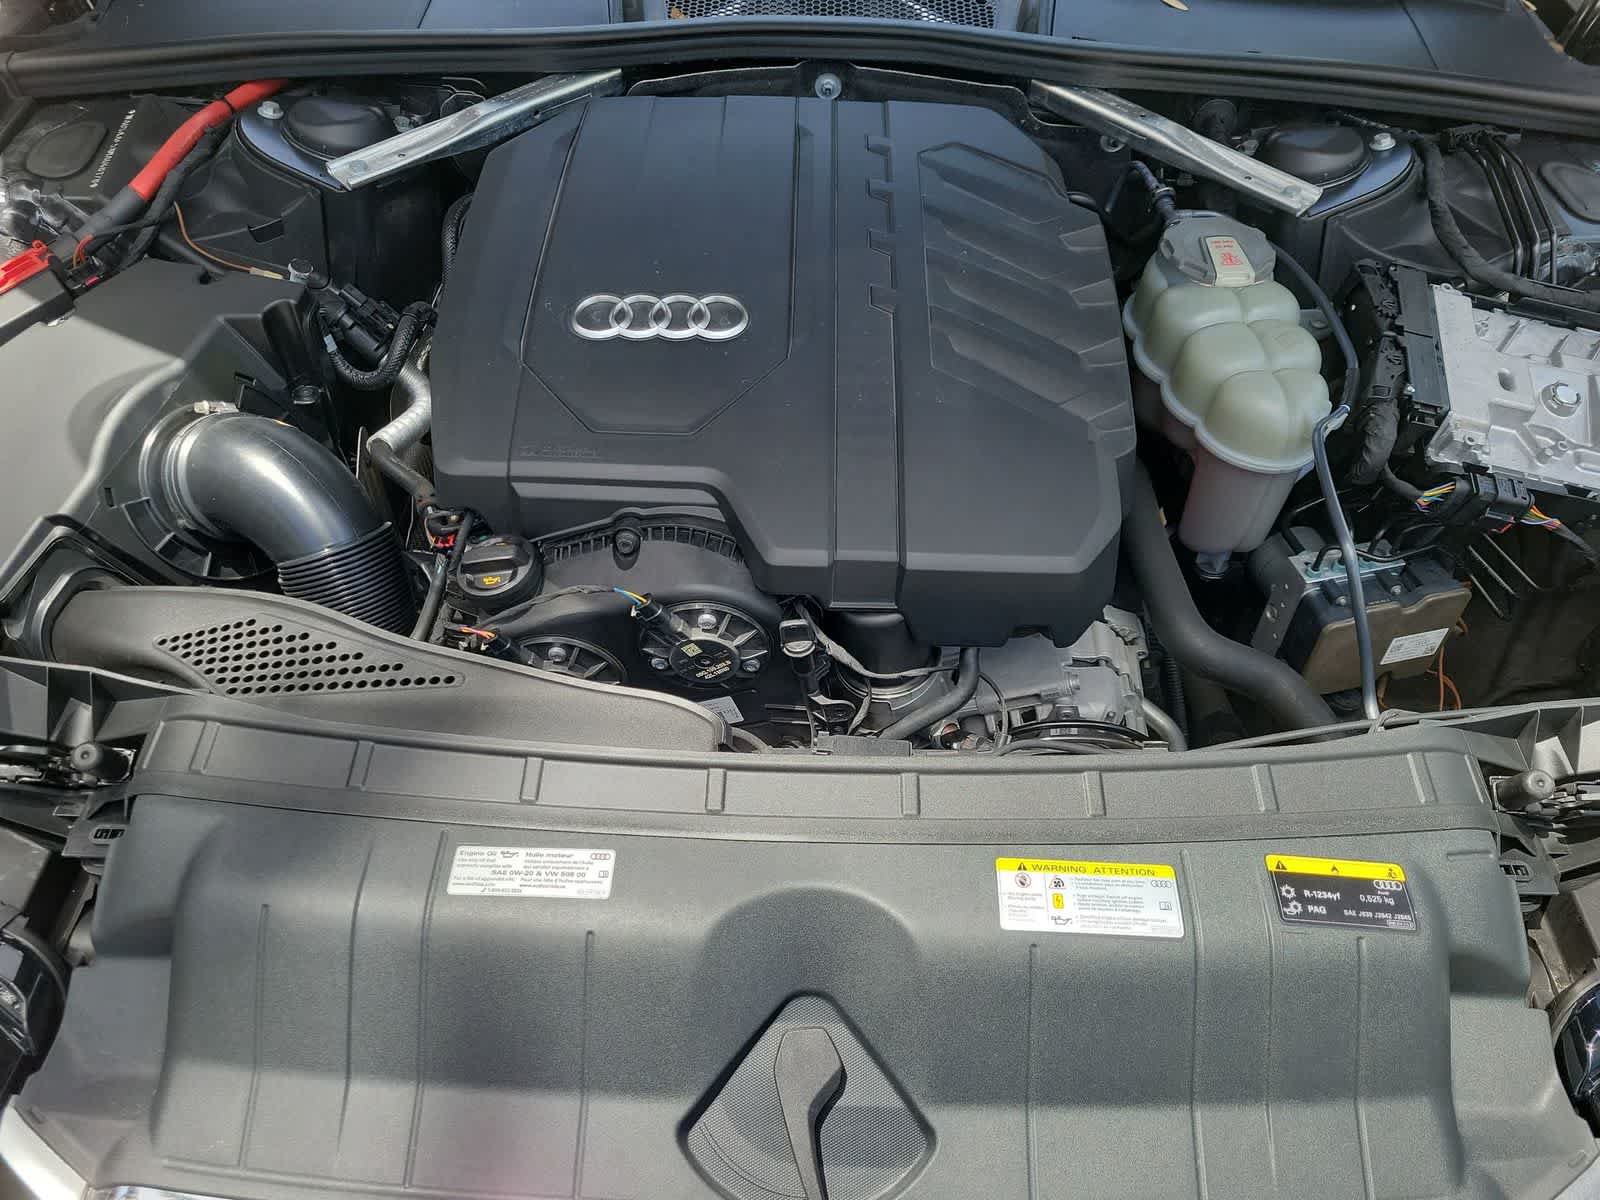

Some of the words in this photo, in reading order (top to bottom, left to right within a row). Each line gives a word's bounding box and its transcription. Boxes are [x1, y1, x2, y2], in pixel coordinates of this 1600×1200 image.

[1031, 863, 1087, 874] WARNING
[1093, 866, 1156, 877] ATTENTION
[1383, 895, 1395, 906] kg
[1307, 904, 1327, 914] PAG
